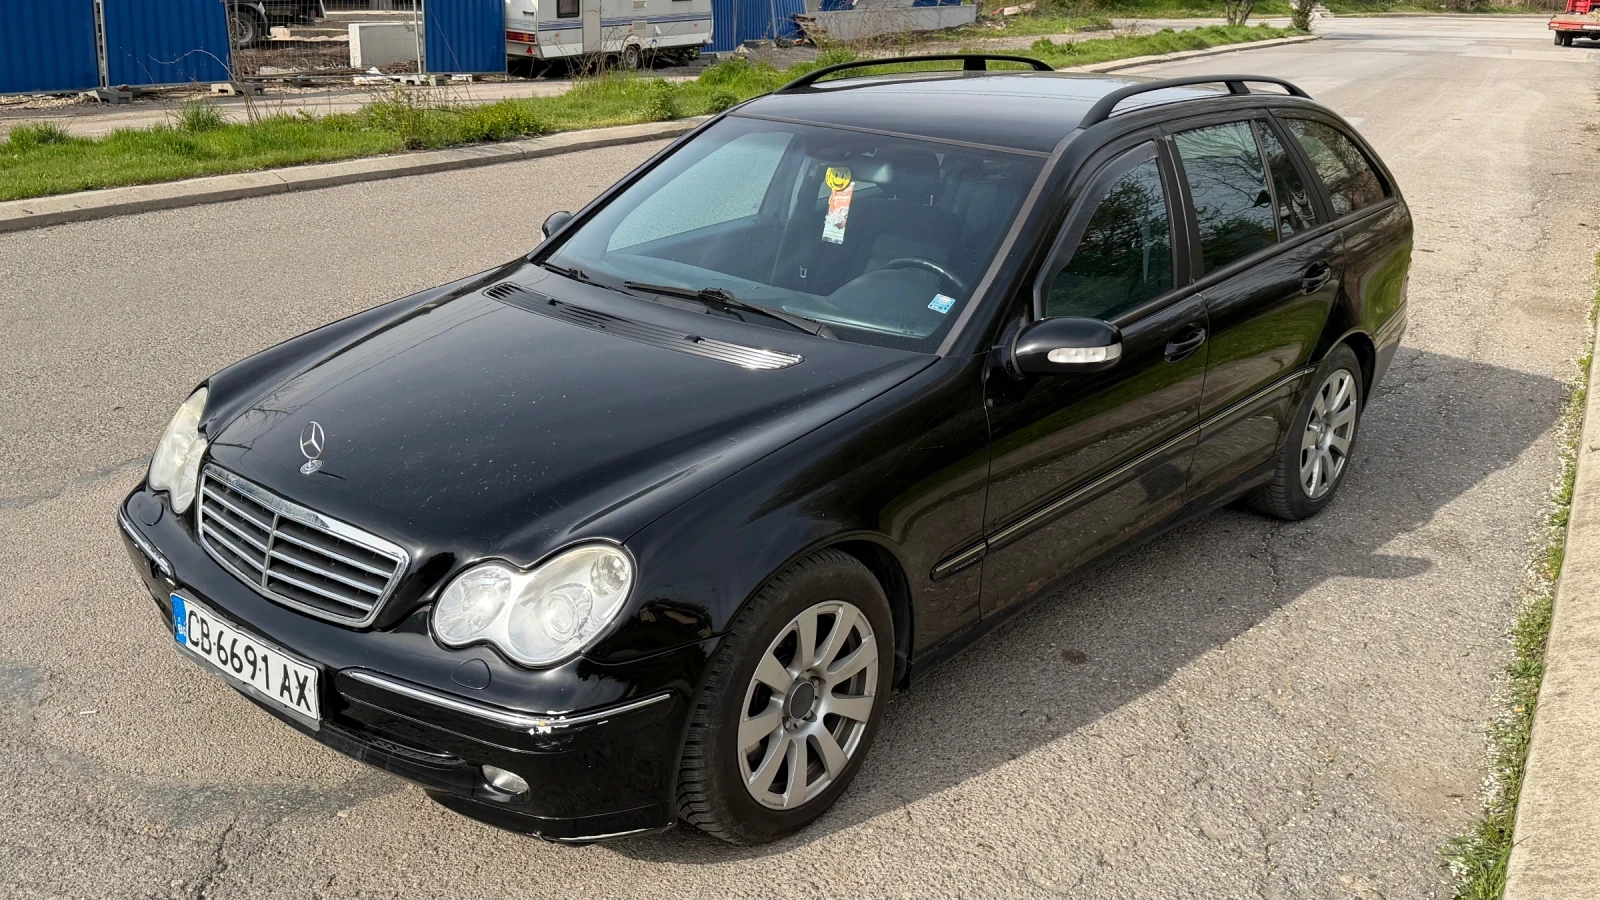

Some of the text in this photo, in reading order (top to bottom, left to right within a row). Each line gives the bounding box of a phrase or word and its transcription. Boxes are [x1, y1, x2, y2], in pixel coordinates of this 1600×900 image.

[188, 610, 311, 712] CB 6691 AX
